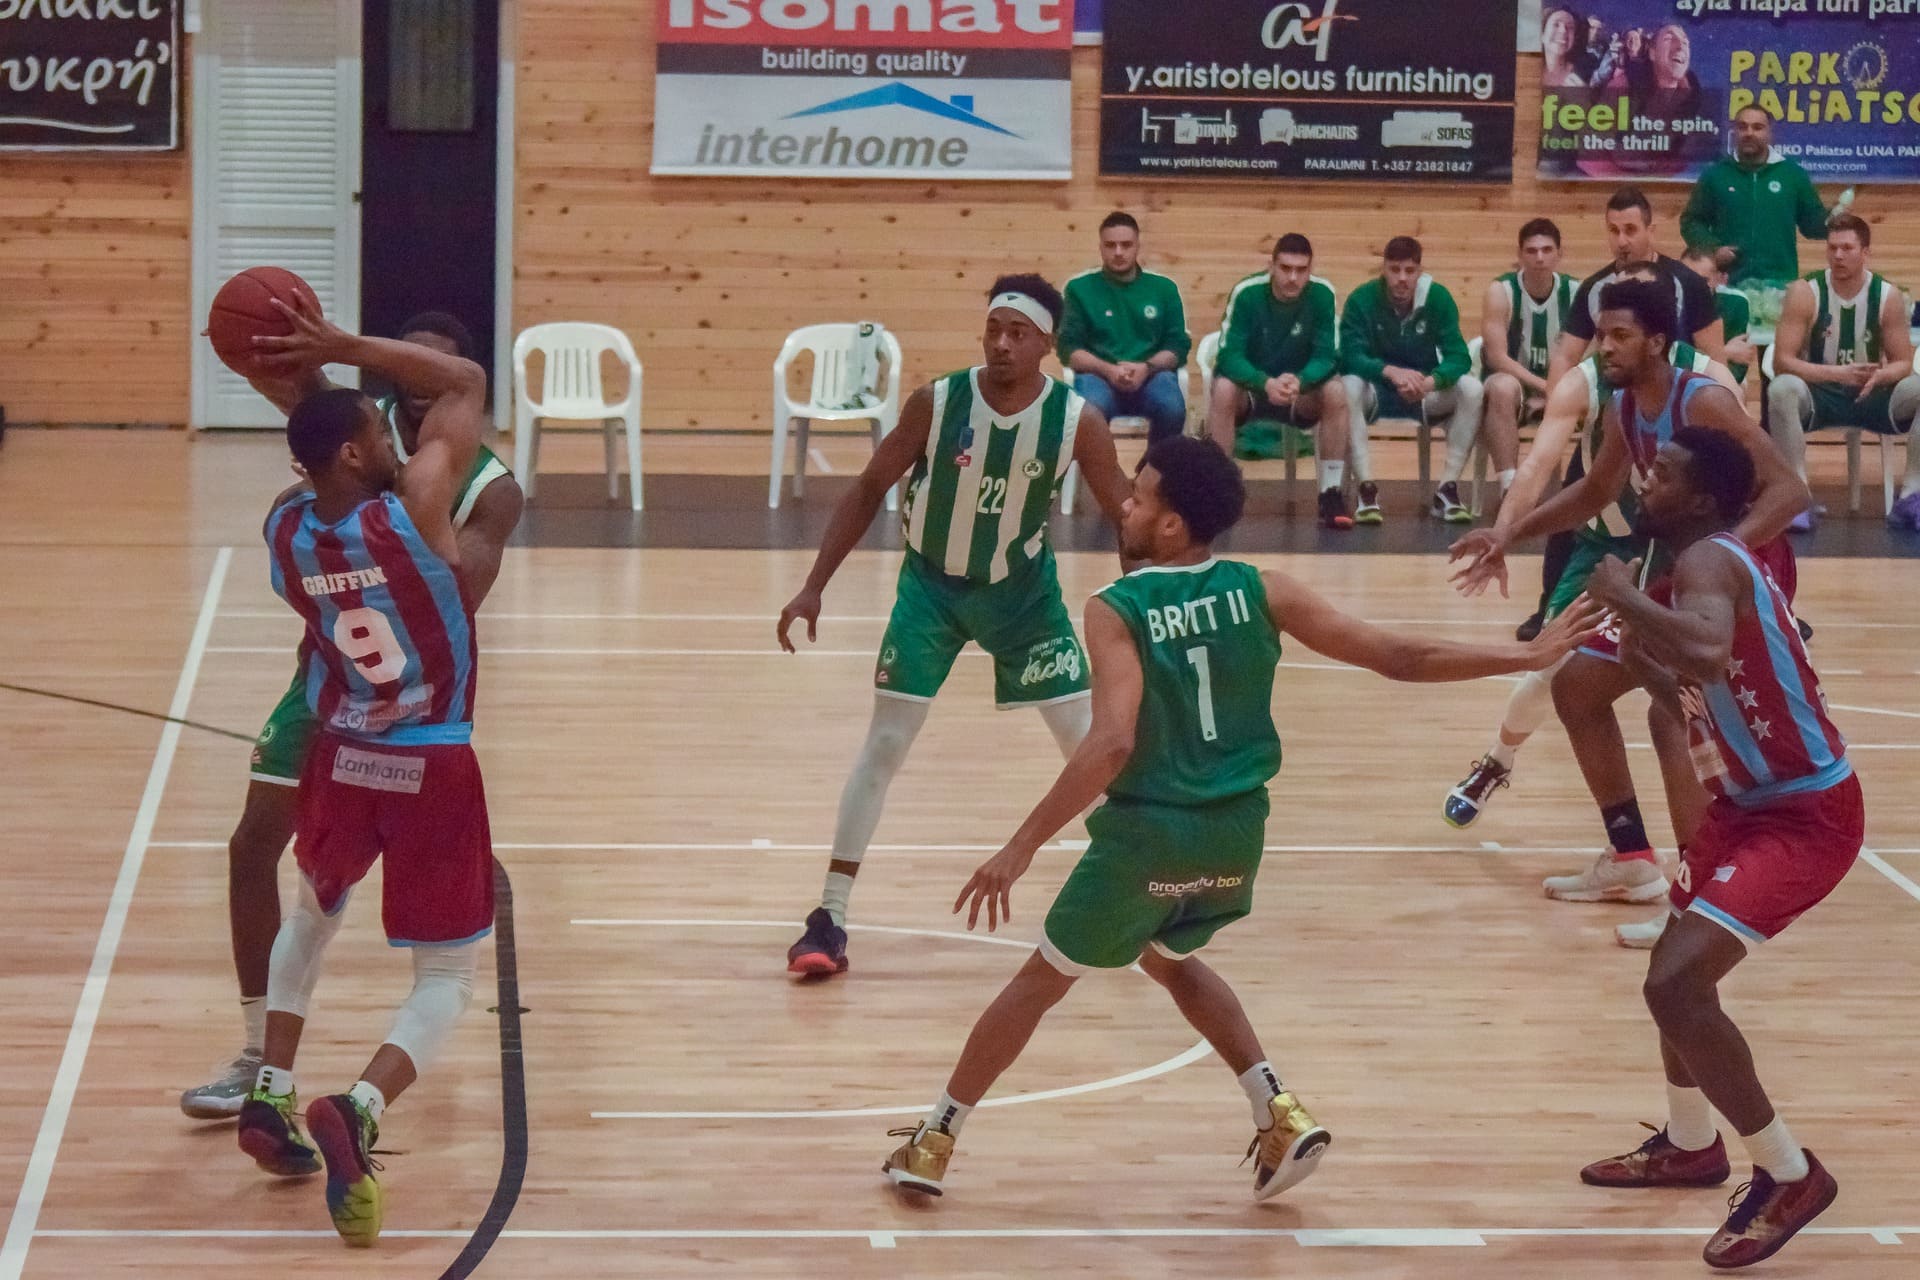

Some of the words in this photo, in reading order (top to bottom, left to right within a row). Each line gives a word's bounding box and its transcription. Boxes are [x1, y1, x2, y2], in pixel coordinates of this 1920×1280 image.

[762, 48, 867, 74] building
[876, 52, 967, 76] quality
[1126, 62, 1336, 92] y.aristotelous
[1345, 65, 1494, 99] furnishing
[1542, 95, 1630, 131] feel
[1632, 115, 1665, 131] the
[1671, 116, 1719, 135] spin,
[695, 124, 969, 167] interhome
[1437, 127, 1473, 141] SOFAS
[1542, 134, 1578, 149] feel
[1583, 134, 1616, 150] the
[1622, 134, 1670, 151] thrill
[1856, 145, 1895, 157] LUNA
[977, 475, 1007, 514] 22
[302, 566, 388, 596] GRIFFIN
[333, 606, 408, 685] 9
[1186, 645, 1218, 741] 1
[1216, 875, 1244, 888] box
